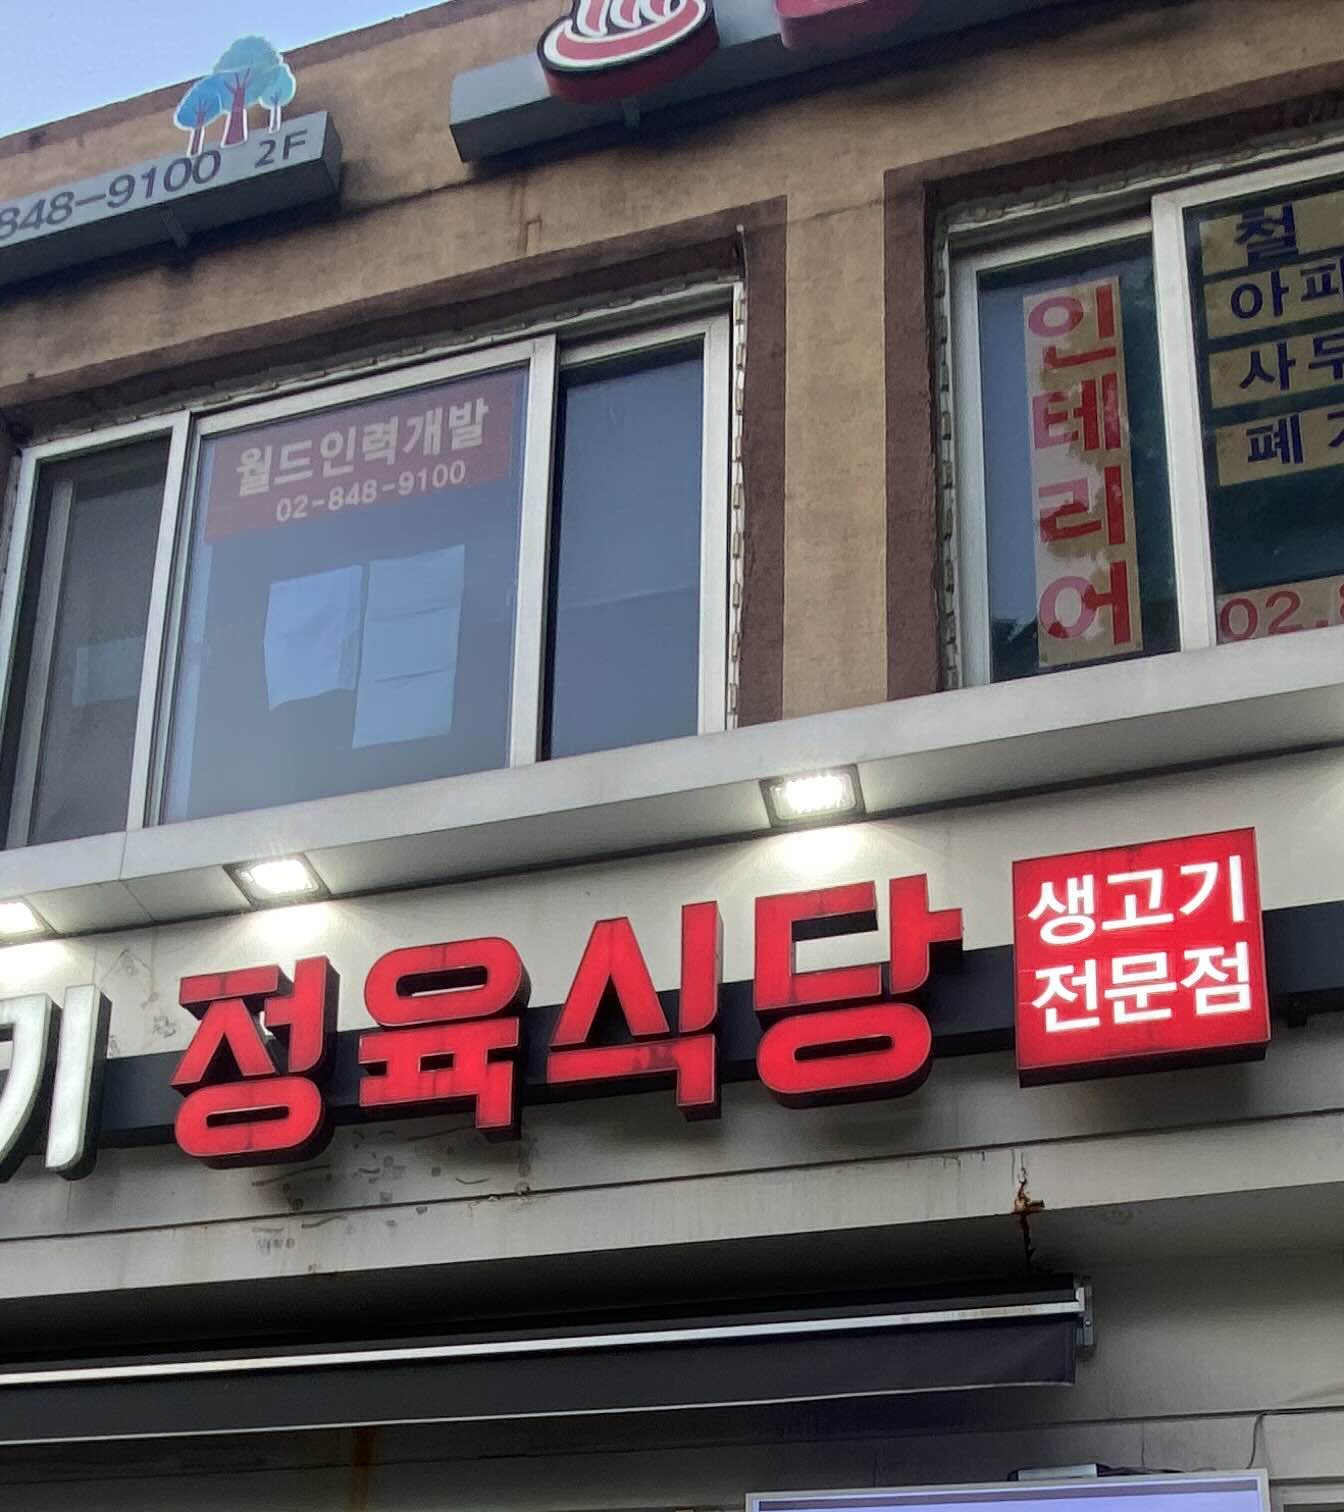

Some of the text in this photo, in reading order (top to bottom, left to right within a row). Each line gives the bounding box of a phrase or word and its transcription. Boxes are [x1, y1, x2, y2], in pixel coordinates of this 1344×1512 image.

[255, 129, 307, 167] 2F
[235, 398, 489, 497] 월드인력개발
[275, 461, 466, 522] 02-848-9100
[1027, 283, 1132, 646] 인테리어
[1027, 855, 1244, 949] 생고기
[172, 872, 964, 1166] 정육식당
[1031, 941, 1253, 1035] 전문점
